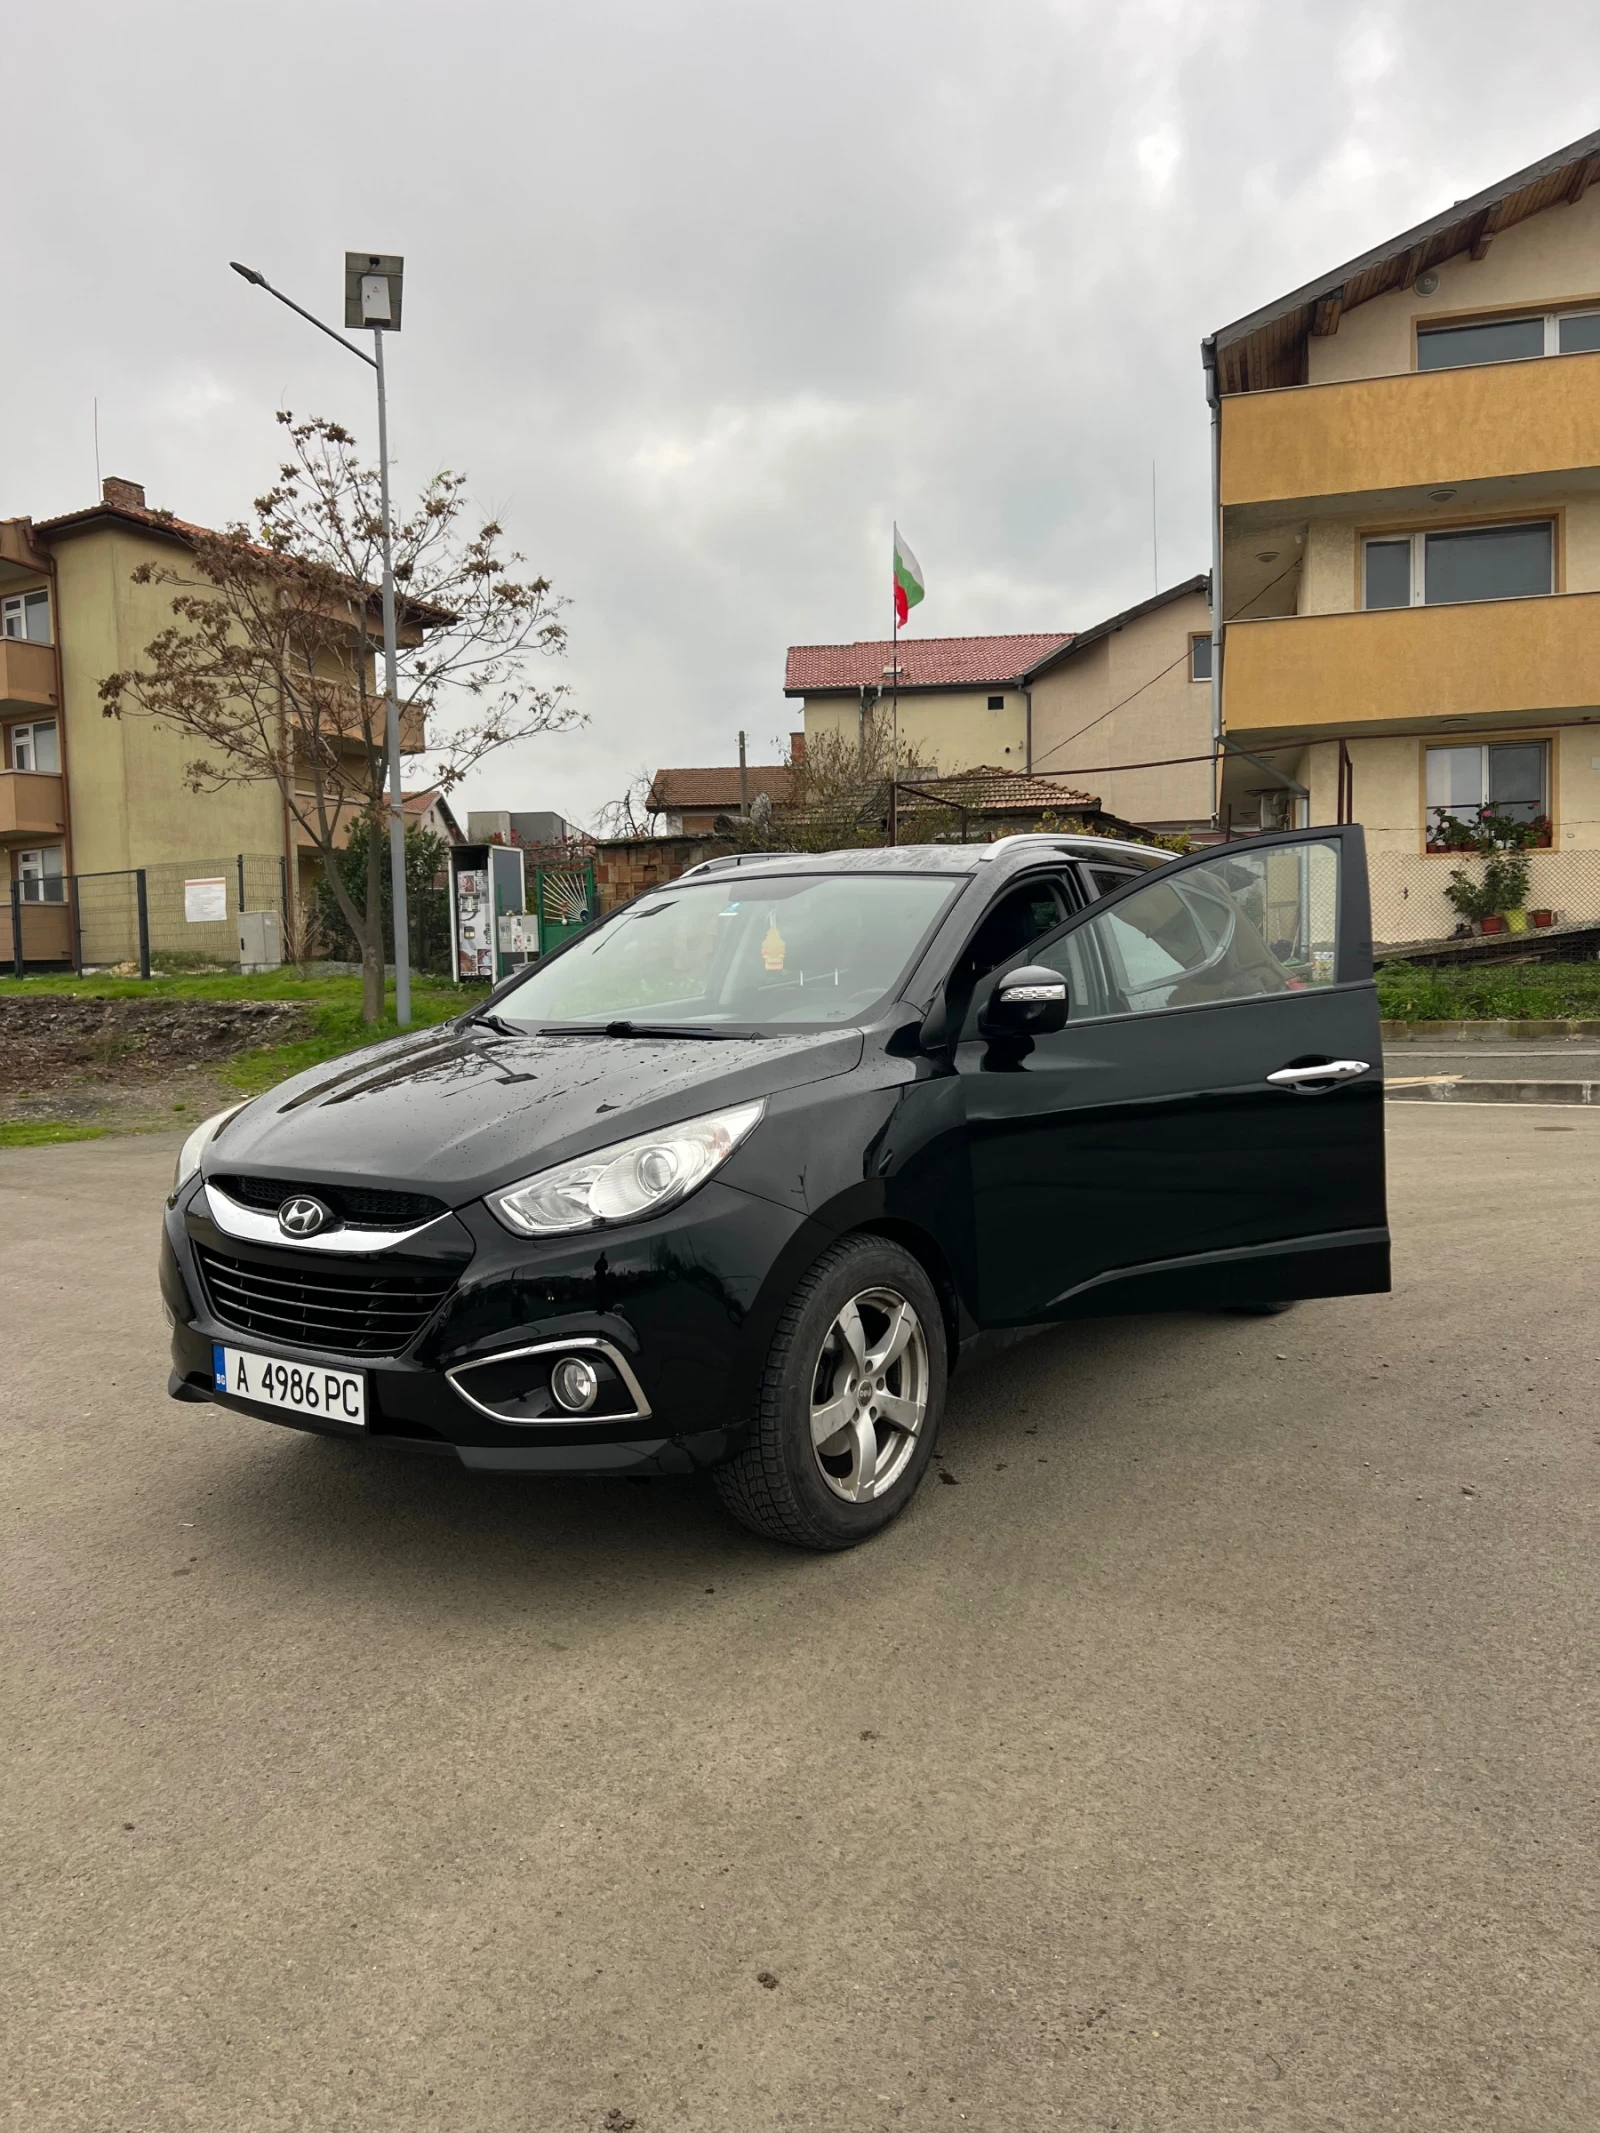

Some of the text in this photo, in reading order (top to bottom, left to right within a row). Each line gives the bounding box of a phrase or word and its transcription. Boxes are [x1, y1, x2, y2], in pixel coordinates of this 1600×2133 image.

[216, 1373, 226, 1385] BG
[237, 1356, 359, 1417] A 4986 PC
